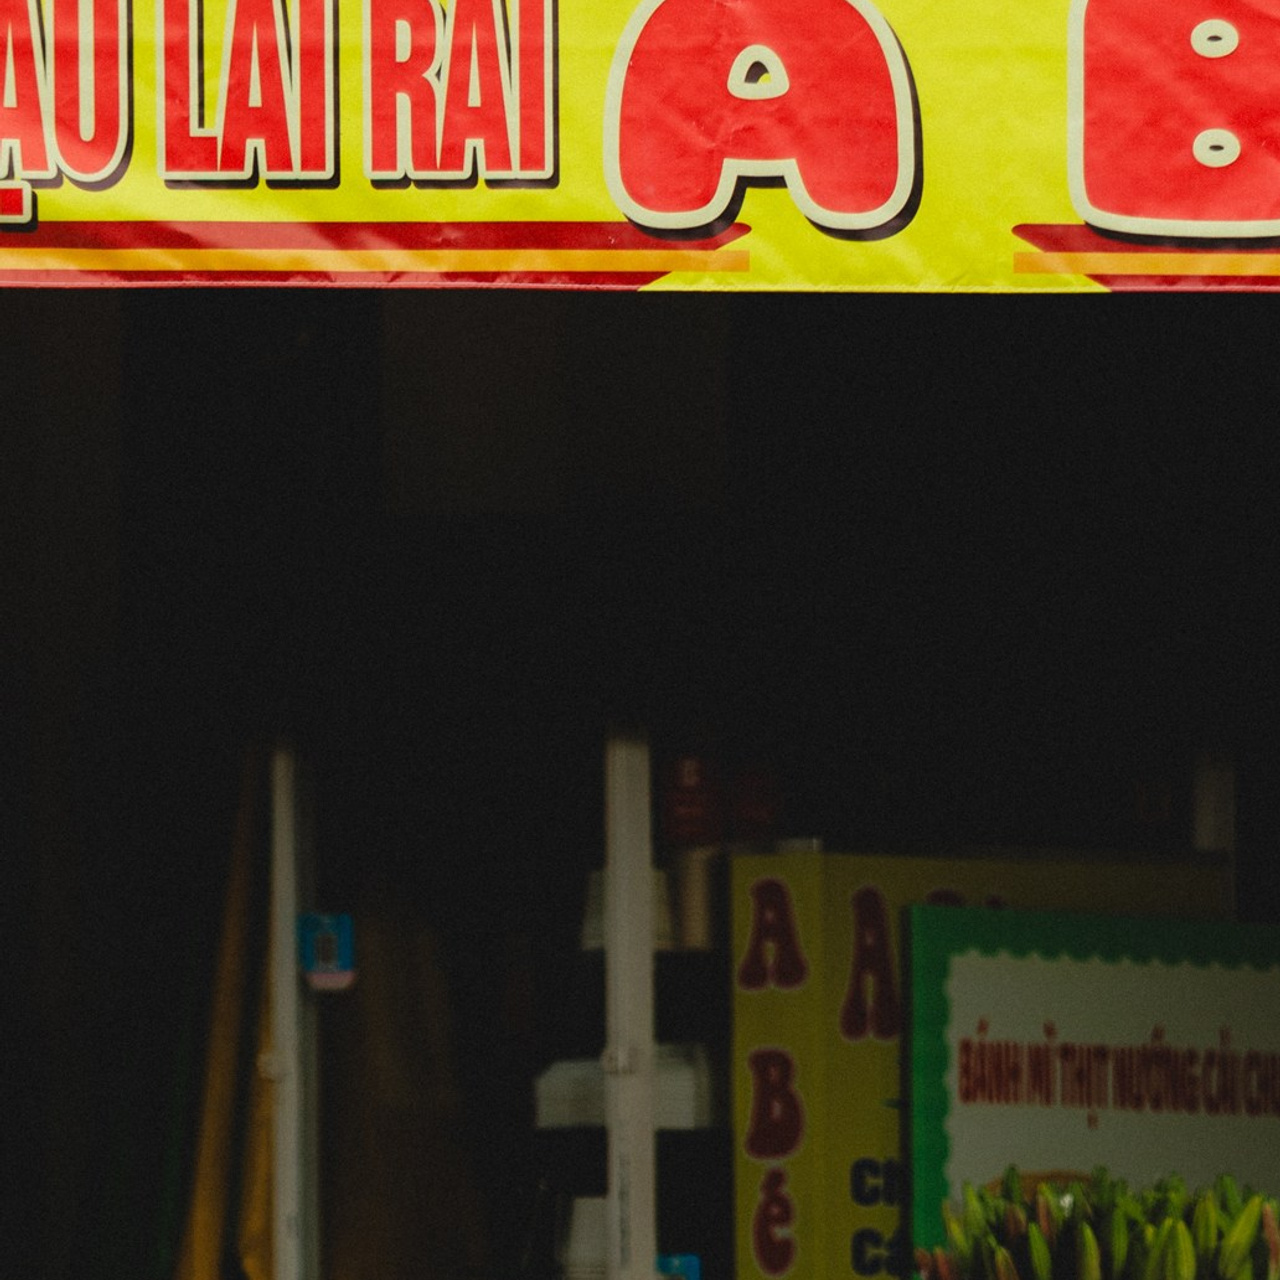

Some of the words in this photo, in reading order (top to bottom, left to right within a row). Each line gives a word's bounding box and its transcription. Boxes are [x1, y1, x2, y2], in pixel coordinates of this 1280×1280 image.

[156, 0, 339, 187] LAI
[364, 0, 559, 187] RAI
[606, 0, 922, 239] A
